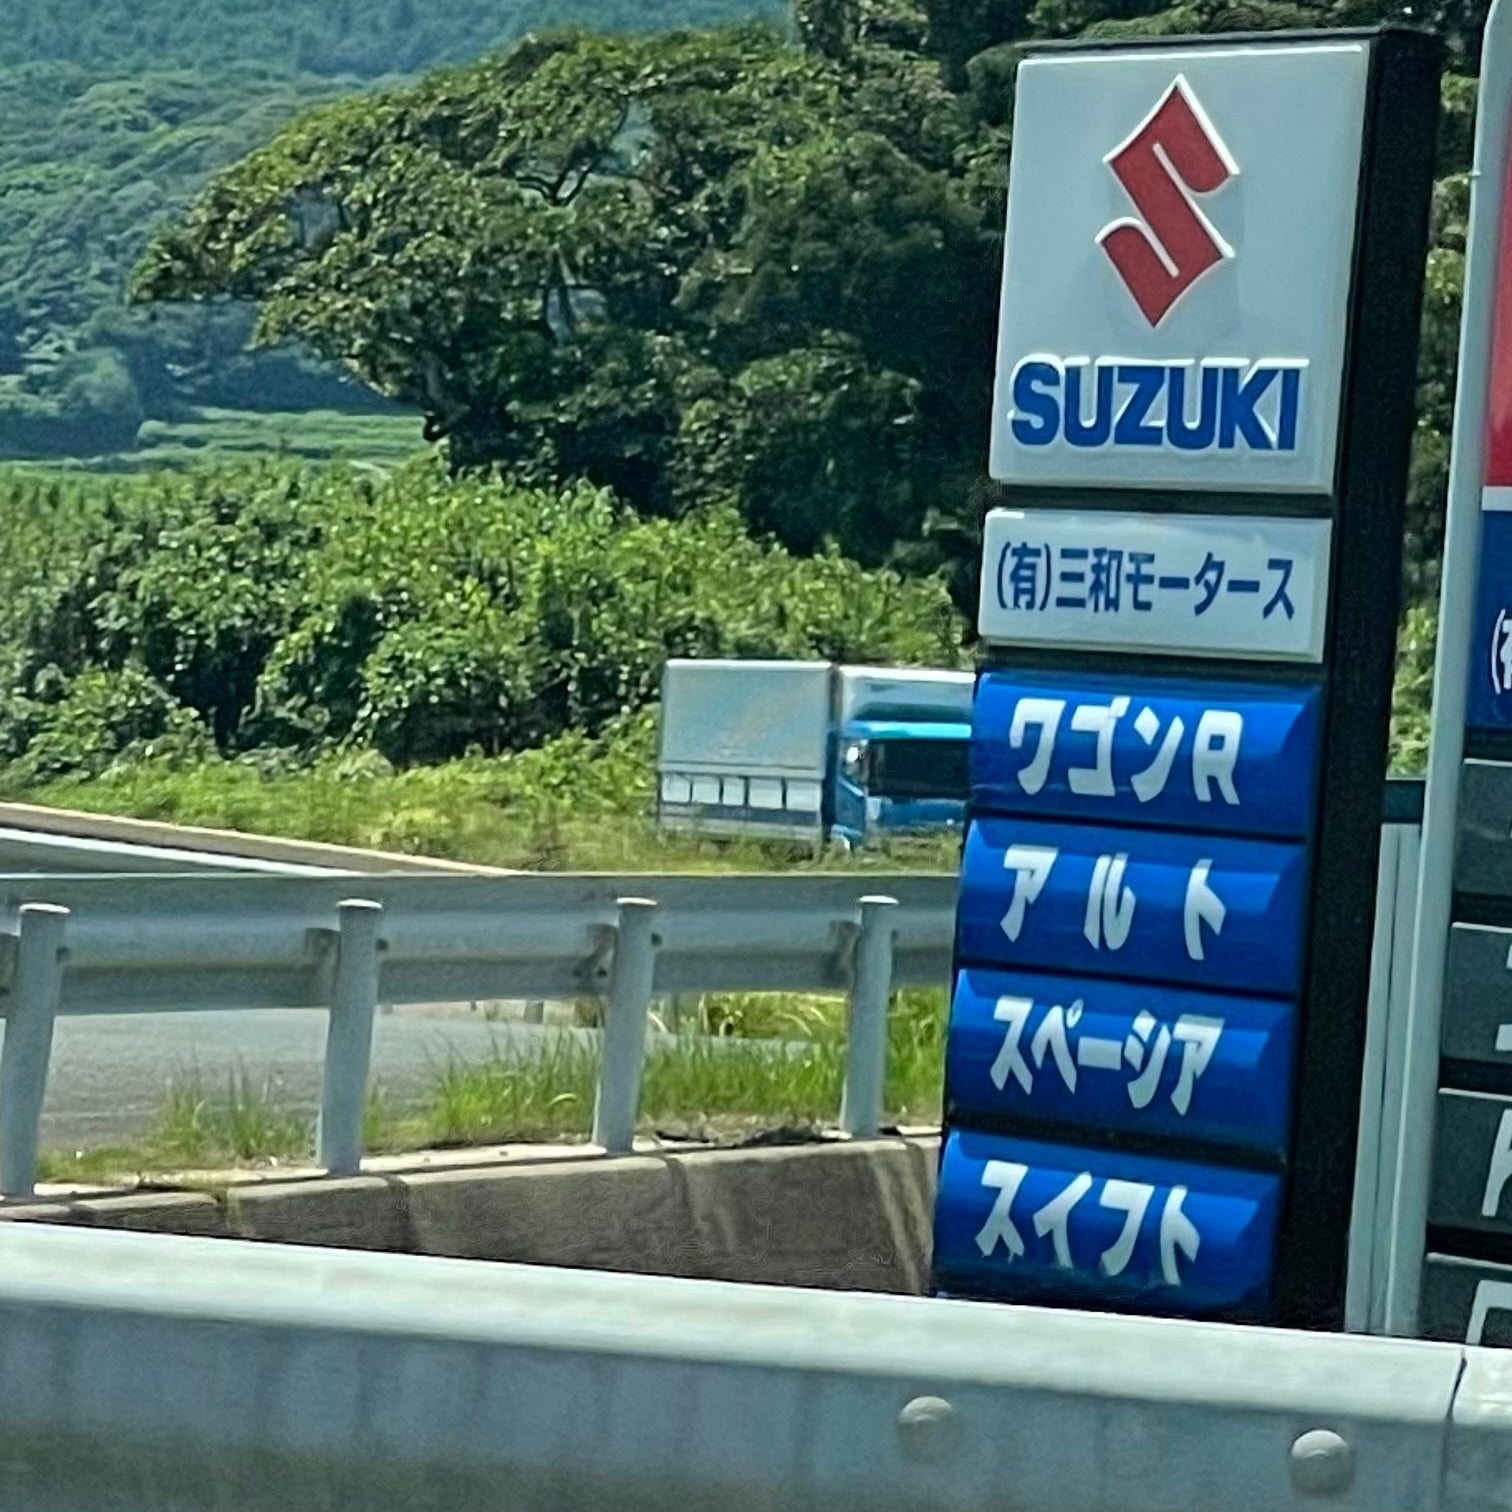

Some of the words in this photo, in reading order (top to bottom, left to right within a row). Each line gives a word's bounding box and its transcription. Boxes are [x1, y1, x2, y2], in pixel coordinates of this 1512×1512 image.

[1008, 354, 1308, 452] SUZUKI
[996, 540, 1295, 621] (有)三和モータース
[1008, 695, 1241, 806] ワゴンR
[999, 843, 1227, 961] アルト
[989, 994, 1226, 1117] スペーシア
[973, 1159, 1202, 1286] スイフト
